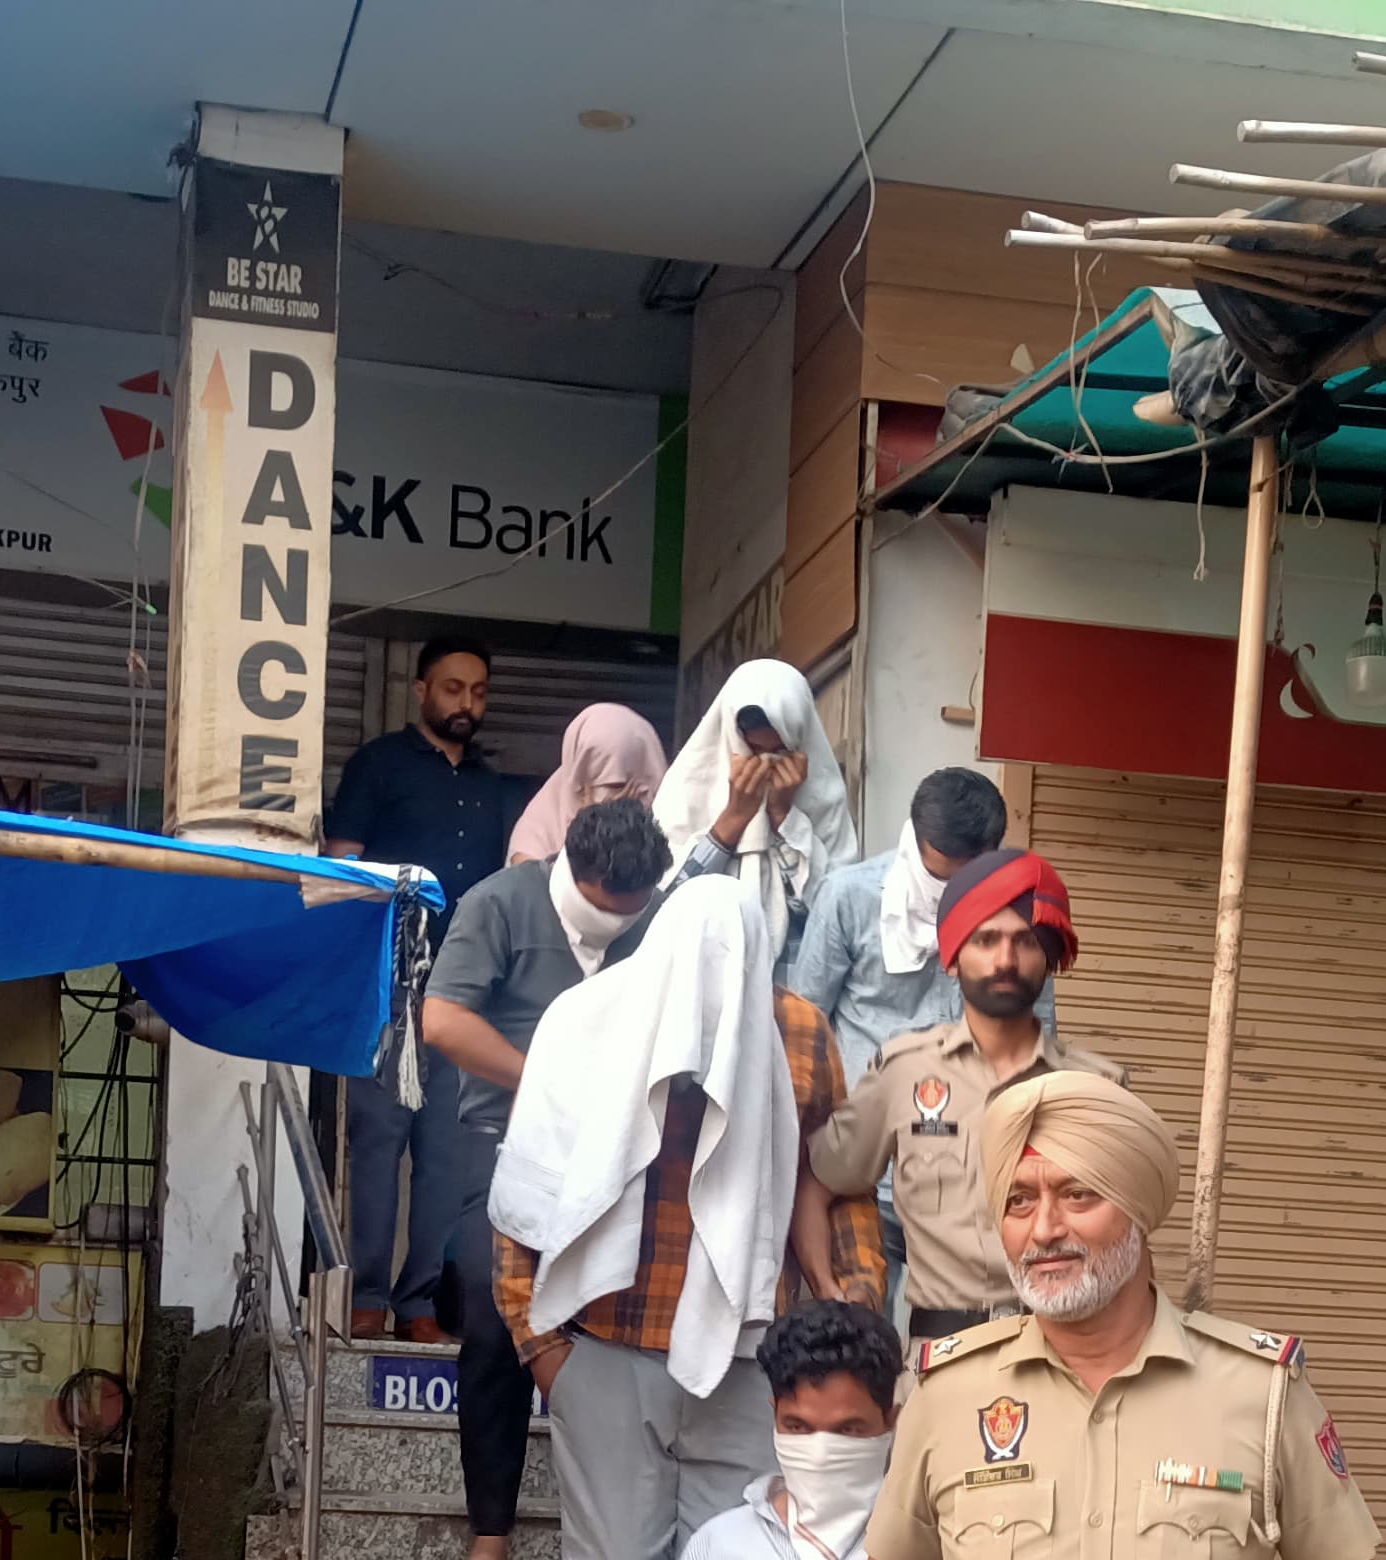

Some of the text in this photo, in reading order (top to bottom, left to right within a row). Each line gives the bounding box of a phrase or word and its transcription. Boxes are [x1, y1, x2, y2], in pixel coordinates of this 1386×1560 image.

[208, 289, 240, 310] DANCE
[250, 294, 286, 316] FITNESS
[286, 300, 320, 320] STUDIO
[226, 256, 303, 295] BE STAR
[449, 483, 613, 565] Bank
[235, 348, 318, 814] DANCE
